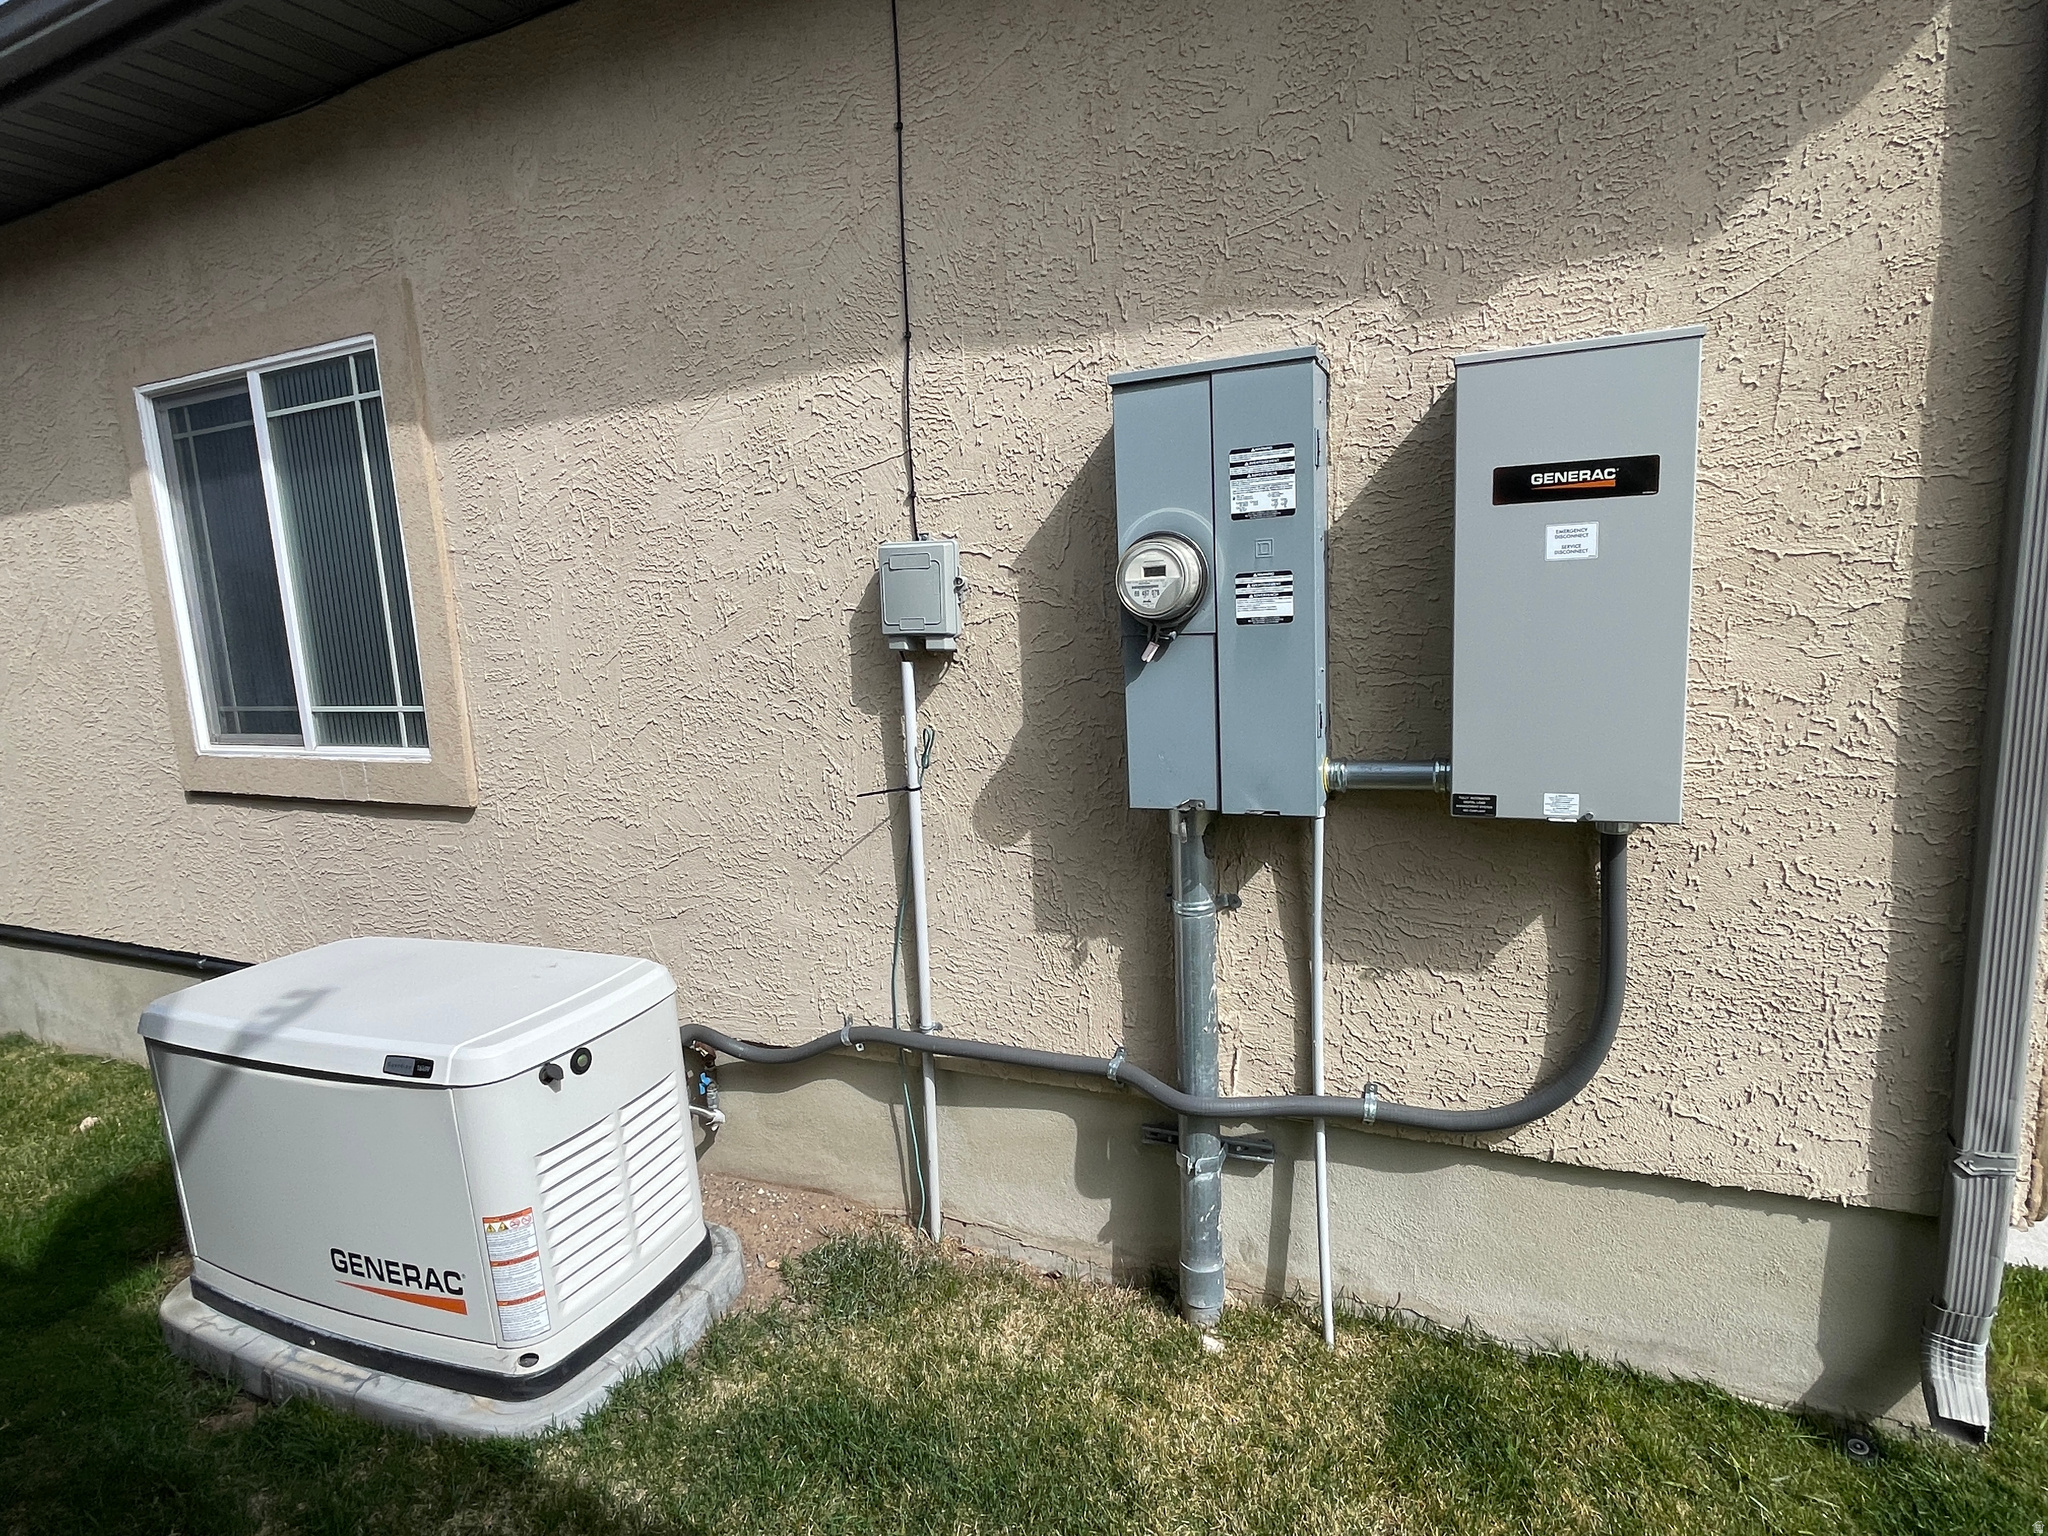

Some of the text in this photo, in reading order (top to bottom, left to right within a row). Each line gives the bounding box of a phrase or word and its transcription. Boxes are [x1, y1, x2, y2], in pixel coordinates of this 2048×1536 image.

[1530, 467, 1617, 486] GENERAC
[1554, 532, 1589, 540] DISCONNECT
[330, 1247, 464, 1296] GENERAC
